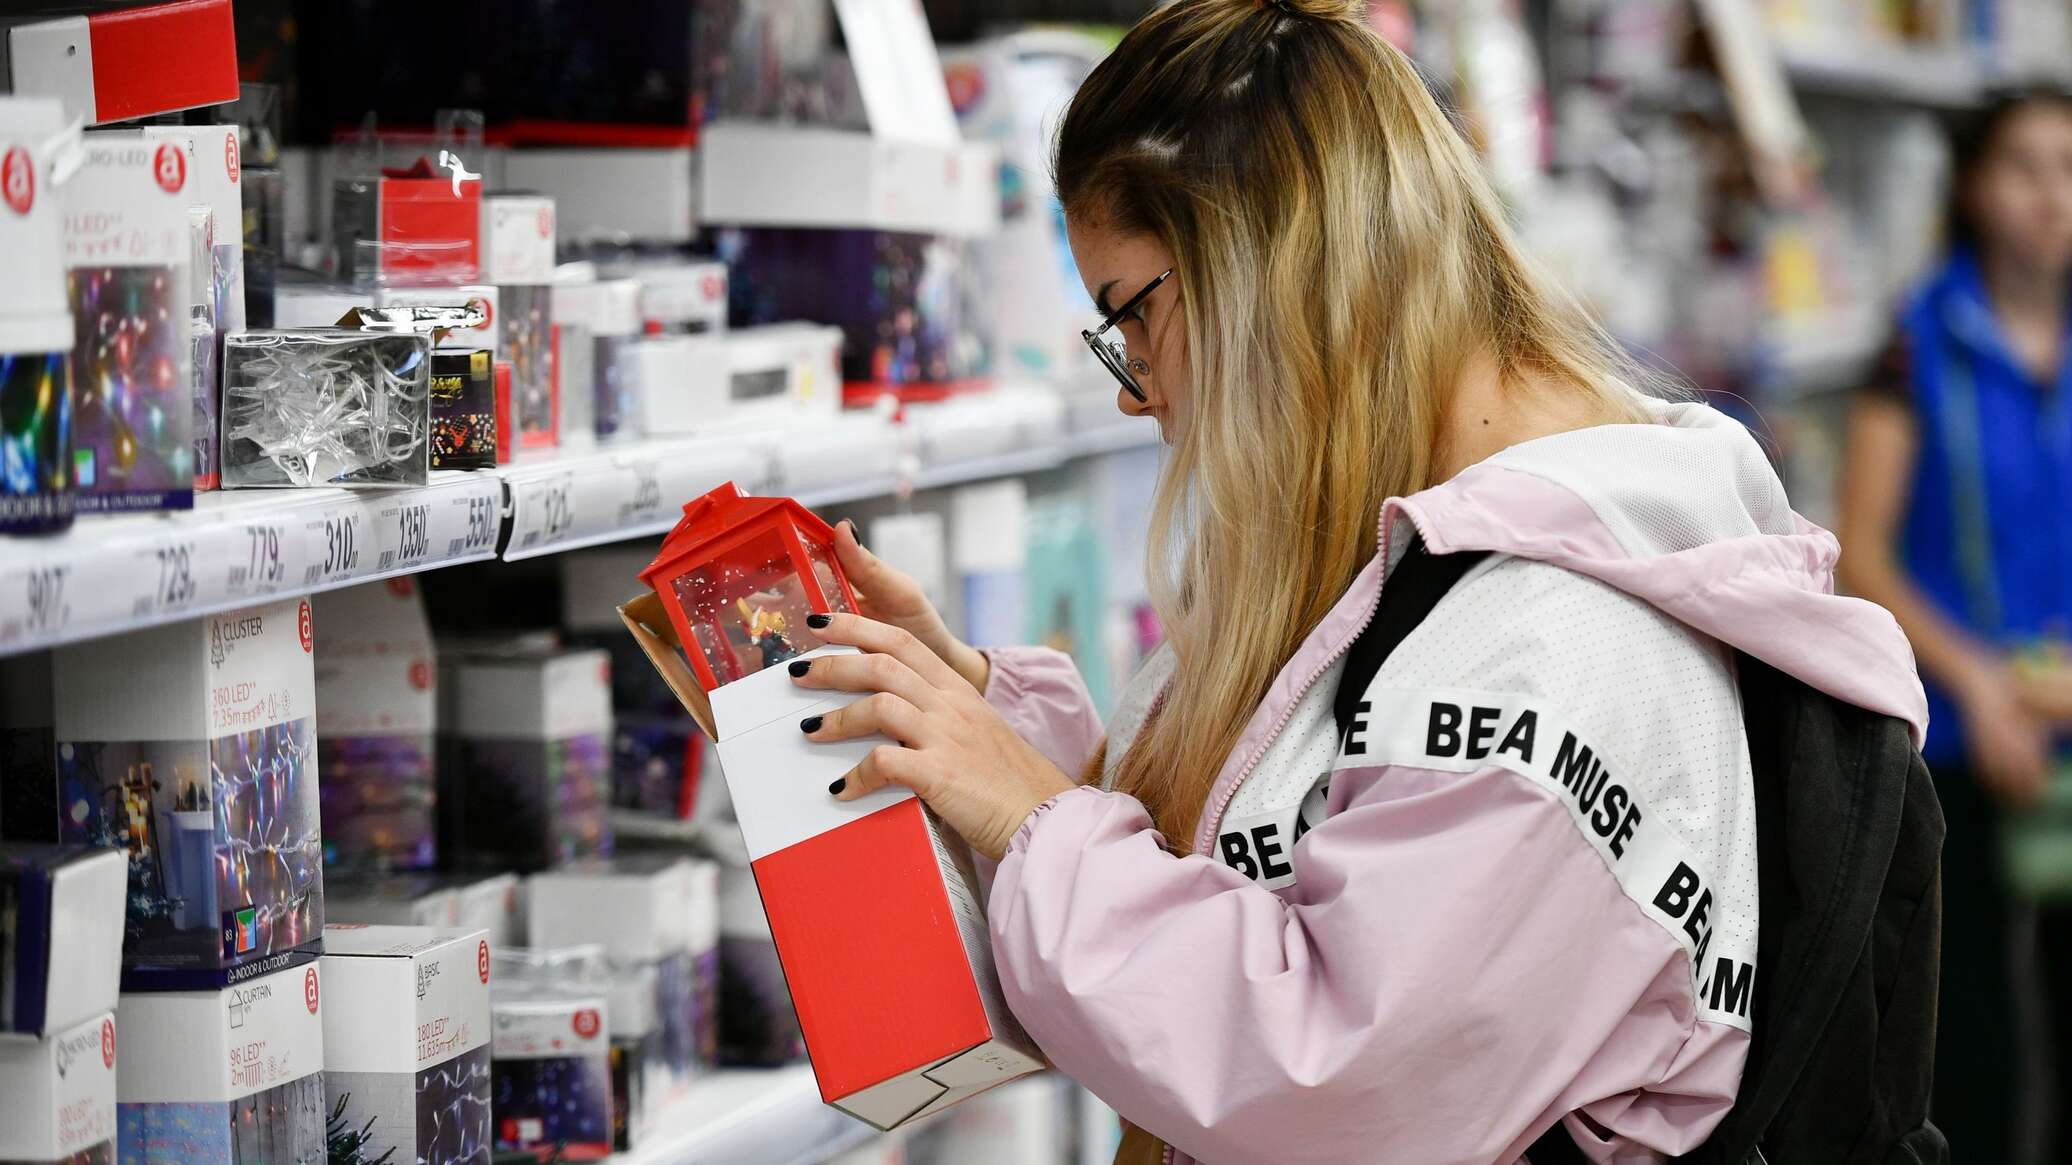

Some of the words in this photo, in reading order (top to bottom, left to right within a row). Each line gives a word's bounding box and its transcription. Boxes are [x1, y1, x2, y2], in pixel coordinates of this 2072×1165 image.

[223, 616, 264, 642] CLUSTER
[1549, 730, 1643, 861] MUSE
[225, 928, 233, 943] 83
[235, 961, 258, 980] INDOOR
[258, 960, 263, 974] &
[242, 984, 272, 1006] CURTAIN
[417, 1023, 431, 1043] 180
[230, 1047, 242, 1067] 96
[231, 1069, 245, 1087] 2m
